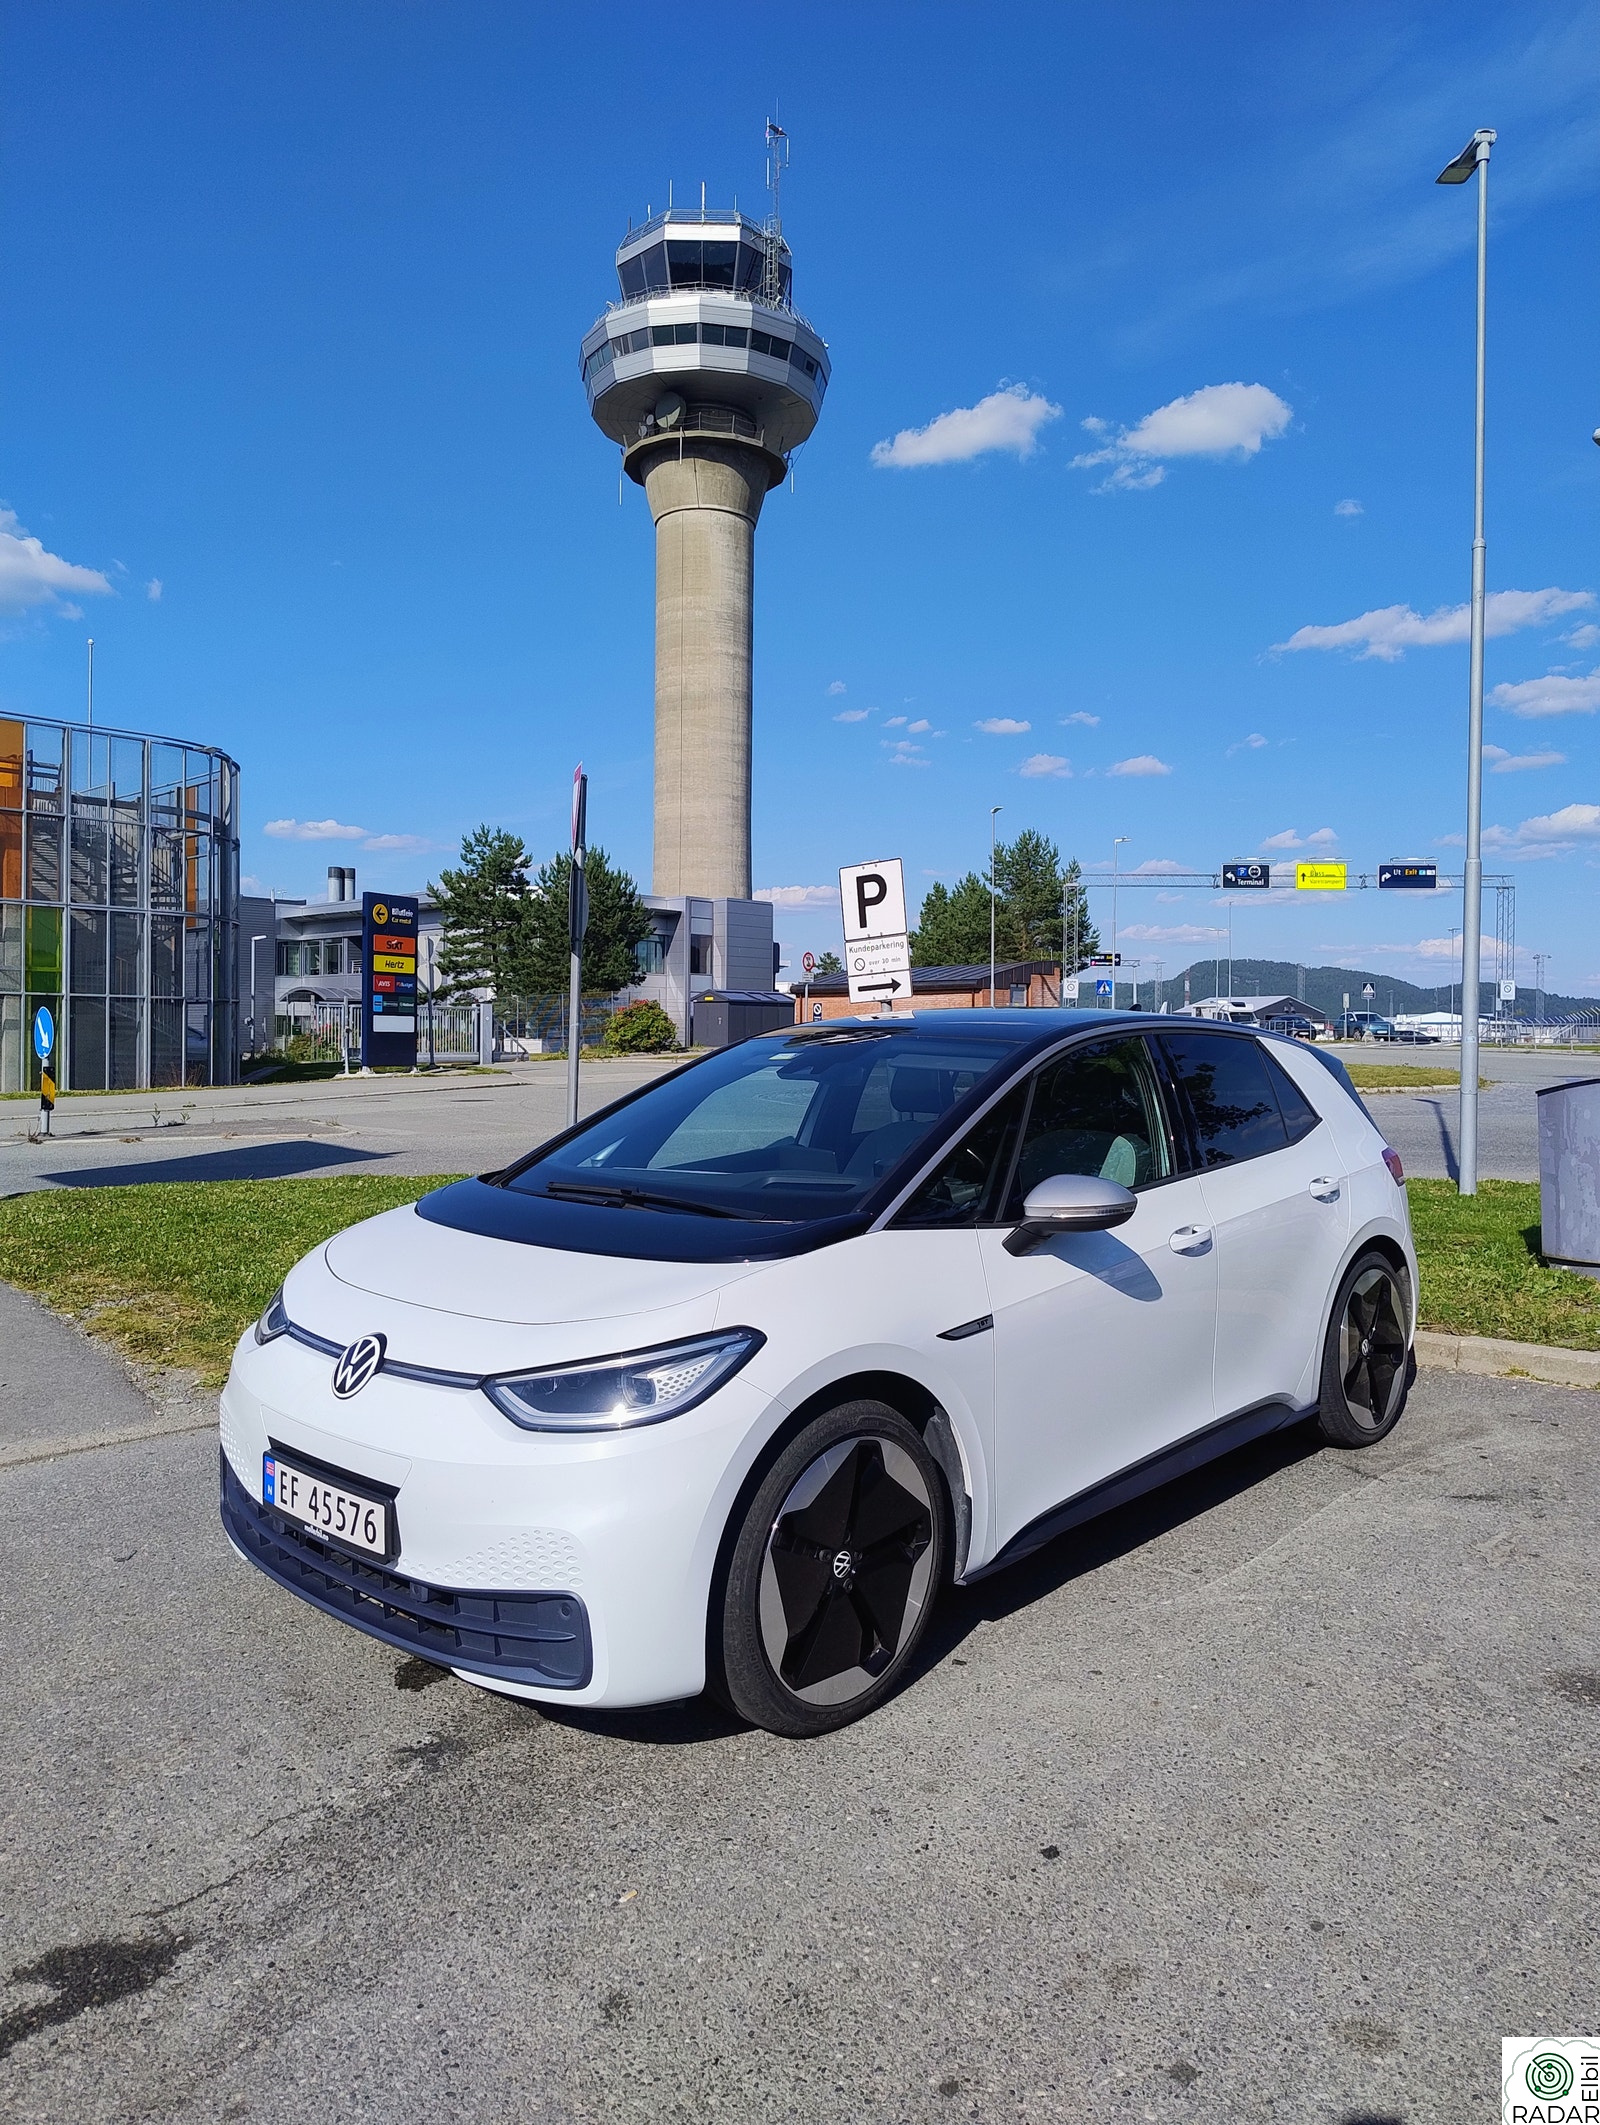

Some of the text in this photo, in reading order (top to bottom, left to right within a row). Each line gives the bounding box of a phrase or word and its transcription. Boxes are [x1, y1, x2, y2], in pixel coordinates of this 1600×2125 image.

[1237, 878, 1265, 886] Terminal
[856, 874, 887, 928] P
[849, 940, 905, 954] Kundeparkering
[385, 959, 405, 970] Hertz
[267, 1484, 273, 1496] N
[280, 1470, 377, 1544] EF 45576
